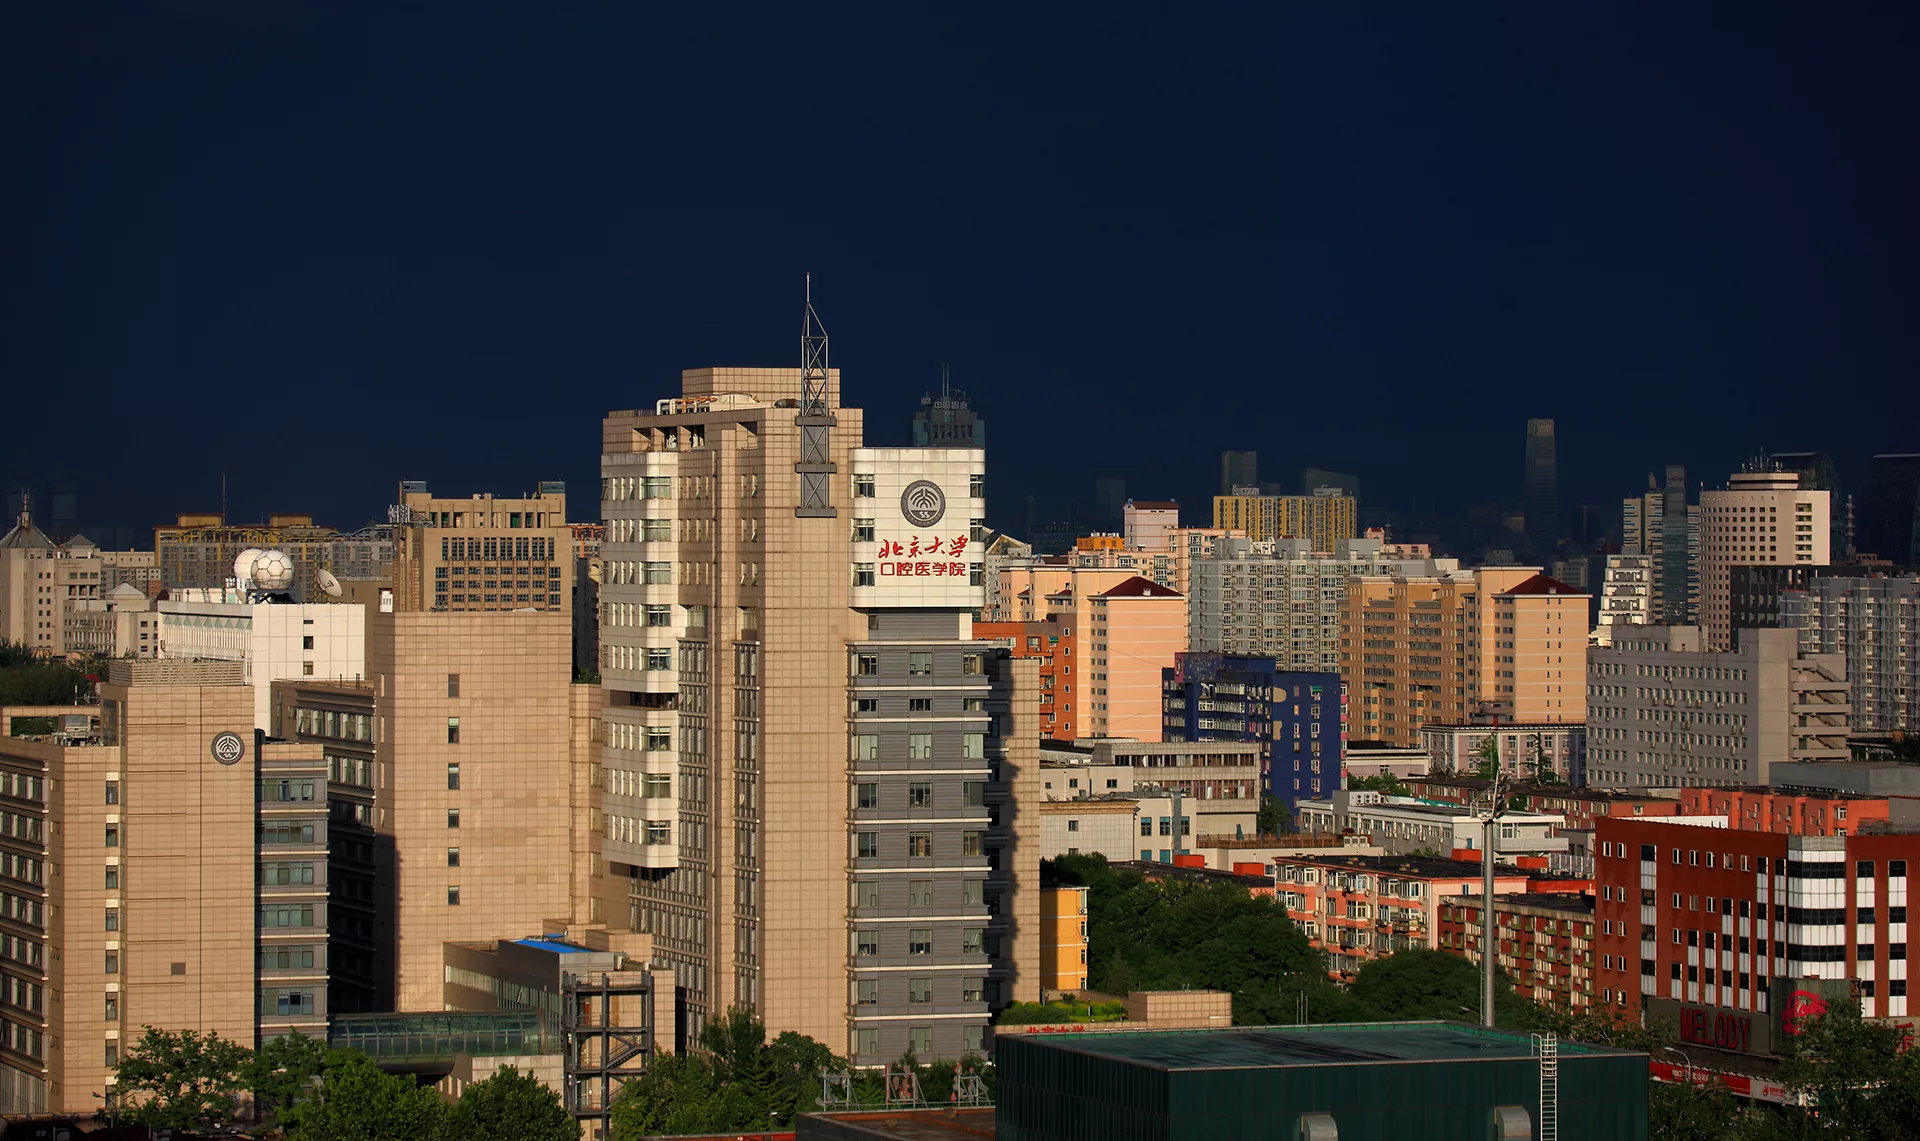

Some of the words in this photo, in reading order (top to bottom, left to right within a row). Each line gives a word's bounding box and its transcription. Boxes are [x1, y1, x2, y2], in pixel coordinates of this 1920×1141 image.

[878, 535, 968, 558] 北京大学
[880, 562, 966, 576] 口腔医学院
[1680, 1007, 1750, 1050] MELODY
